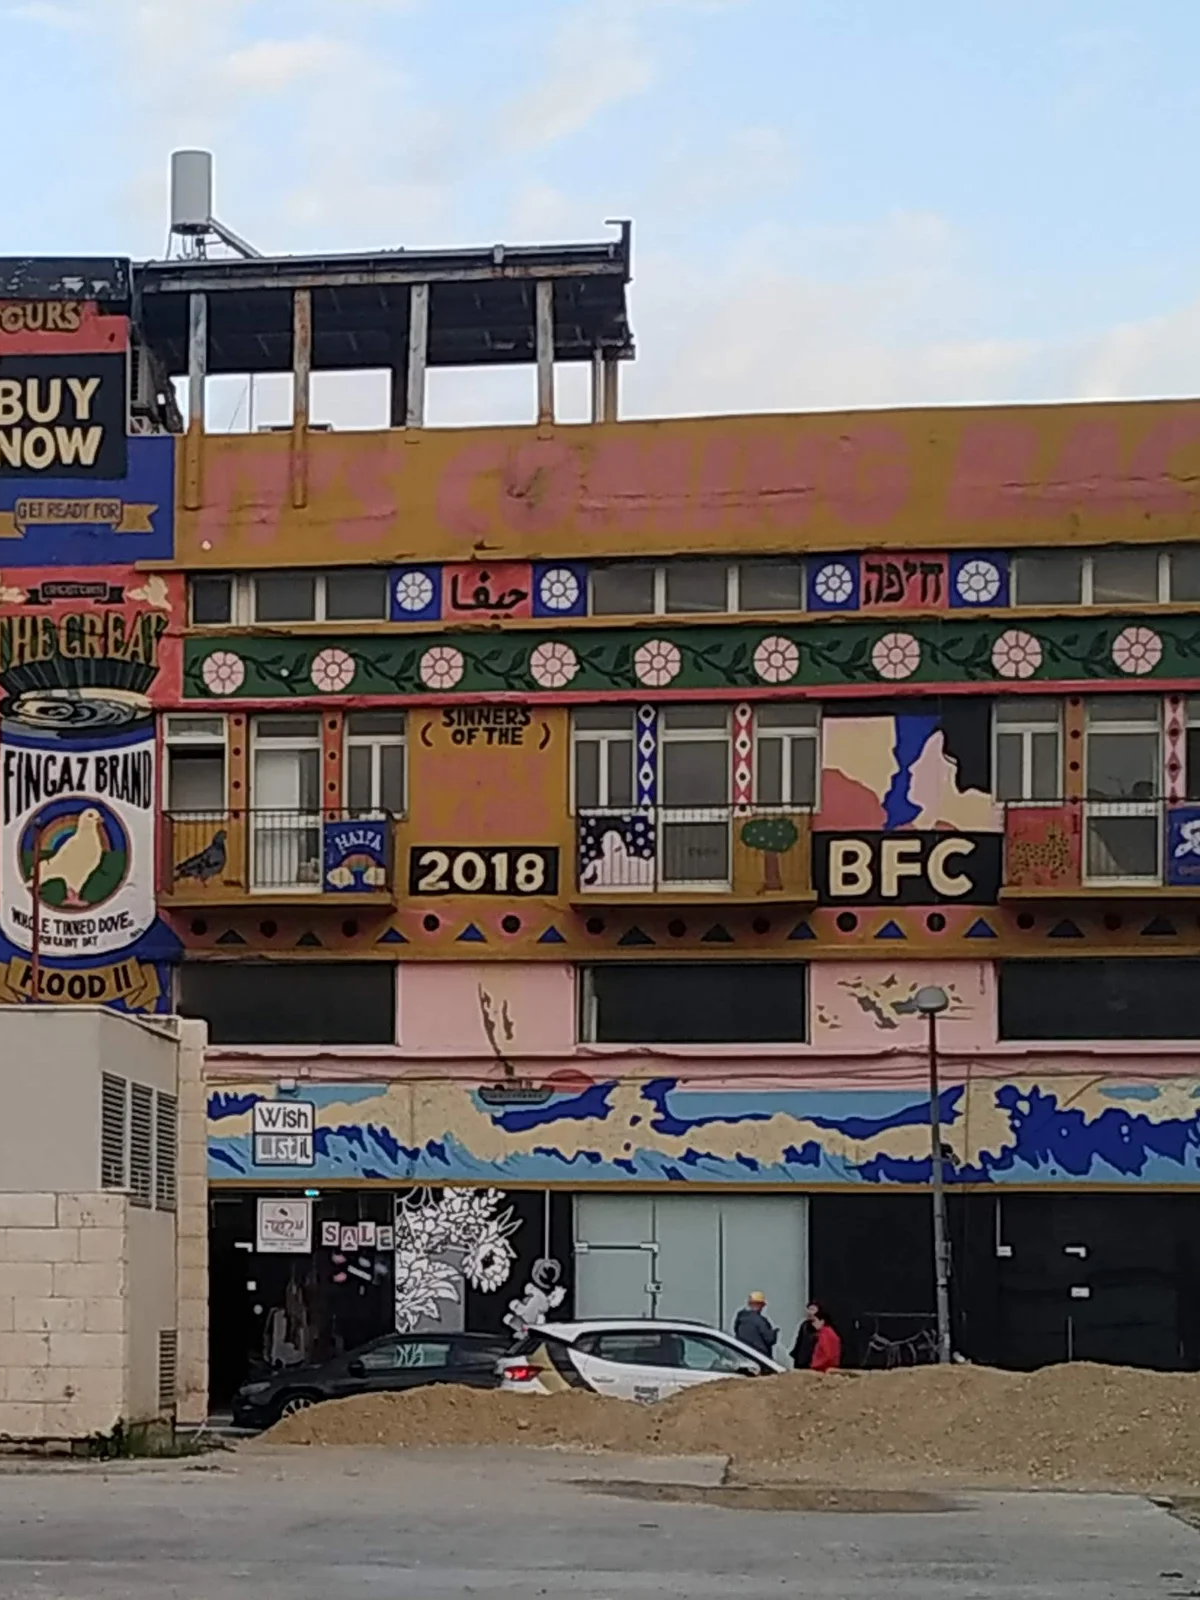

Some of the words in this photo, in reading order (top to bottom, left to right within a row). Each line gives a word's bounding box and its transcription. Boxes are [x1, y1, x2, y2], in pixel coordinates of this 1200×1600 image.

[435, 423, 912, 538] COMING
[17, 501, 45, 519] GET
[46, 501, 91, 519] READY
[93, 501, 120, 518] FOR
[451, 570, 529, 620] حيفا
[862, 559, 945, 606] חיפה
[58, 609, 169, 669] GREAT
[441, 706, 533, 728] SINNERS
[451, 727, 480, 746] OF
[482, 726, 524, 746] THE
[3, 749, 90, 826] FINGAZ
[94, 749, 152, 810] BRAND
[334, 828, 382, 856] HAIFA
[417, 850, 545, 892] 2018
[828, 837, 976, 897] BFC
[10, 905, 50, 934] WHOE
[258, 1106, 309, 1130] Wish
[324, 1224, 392, 1249] SALE
